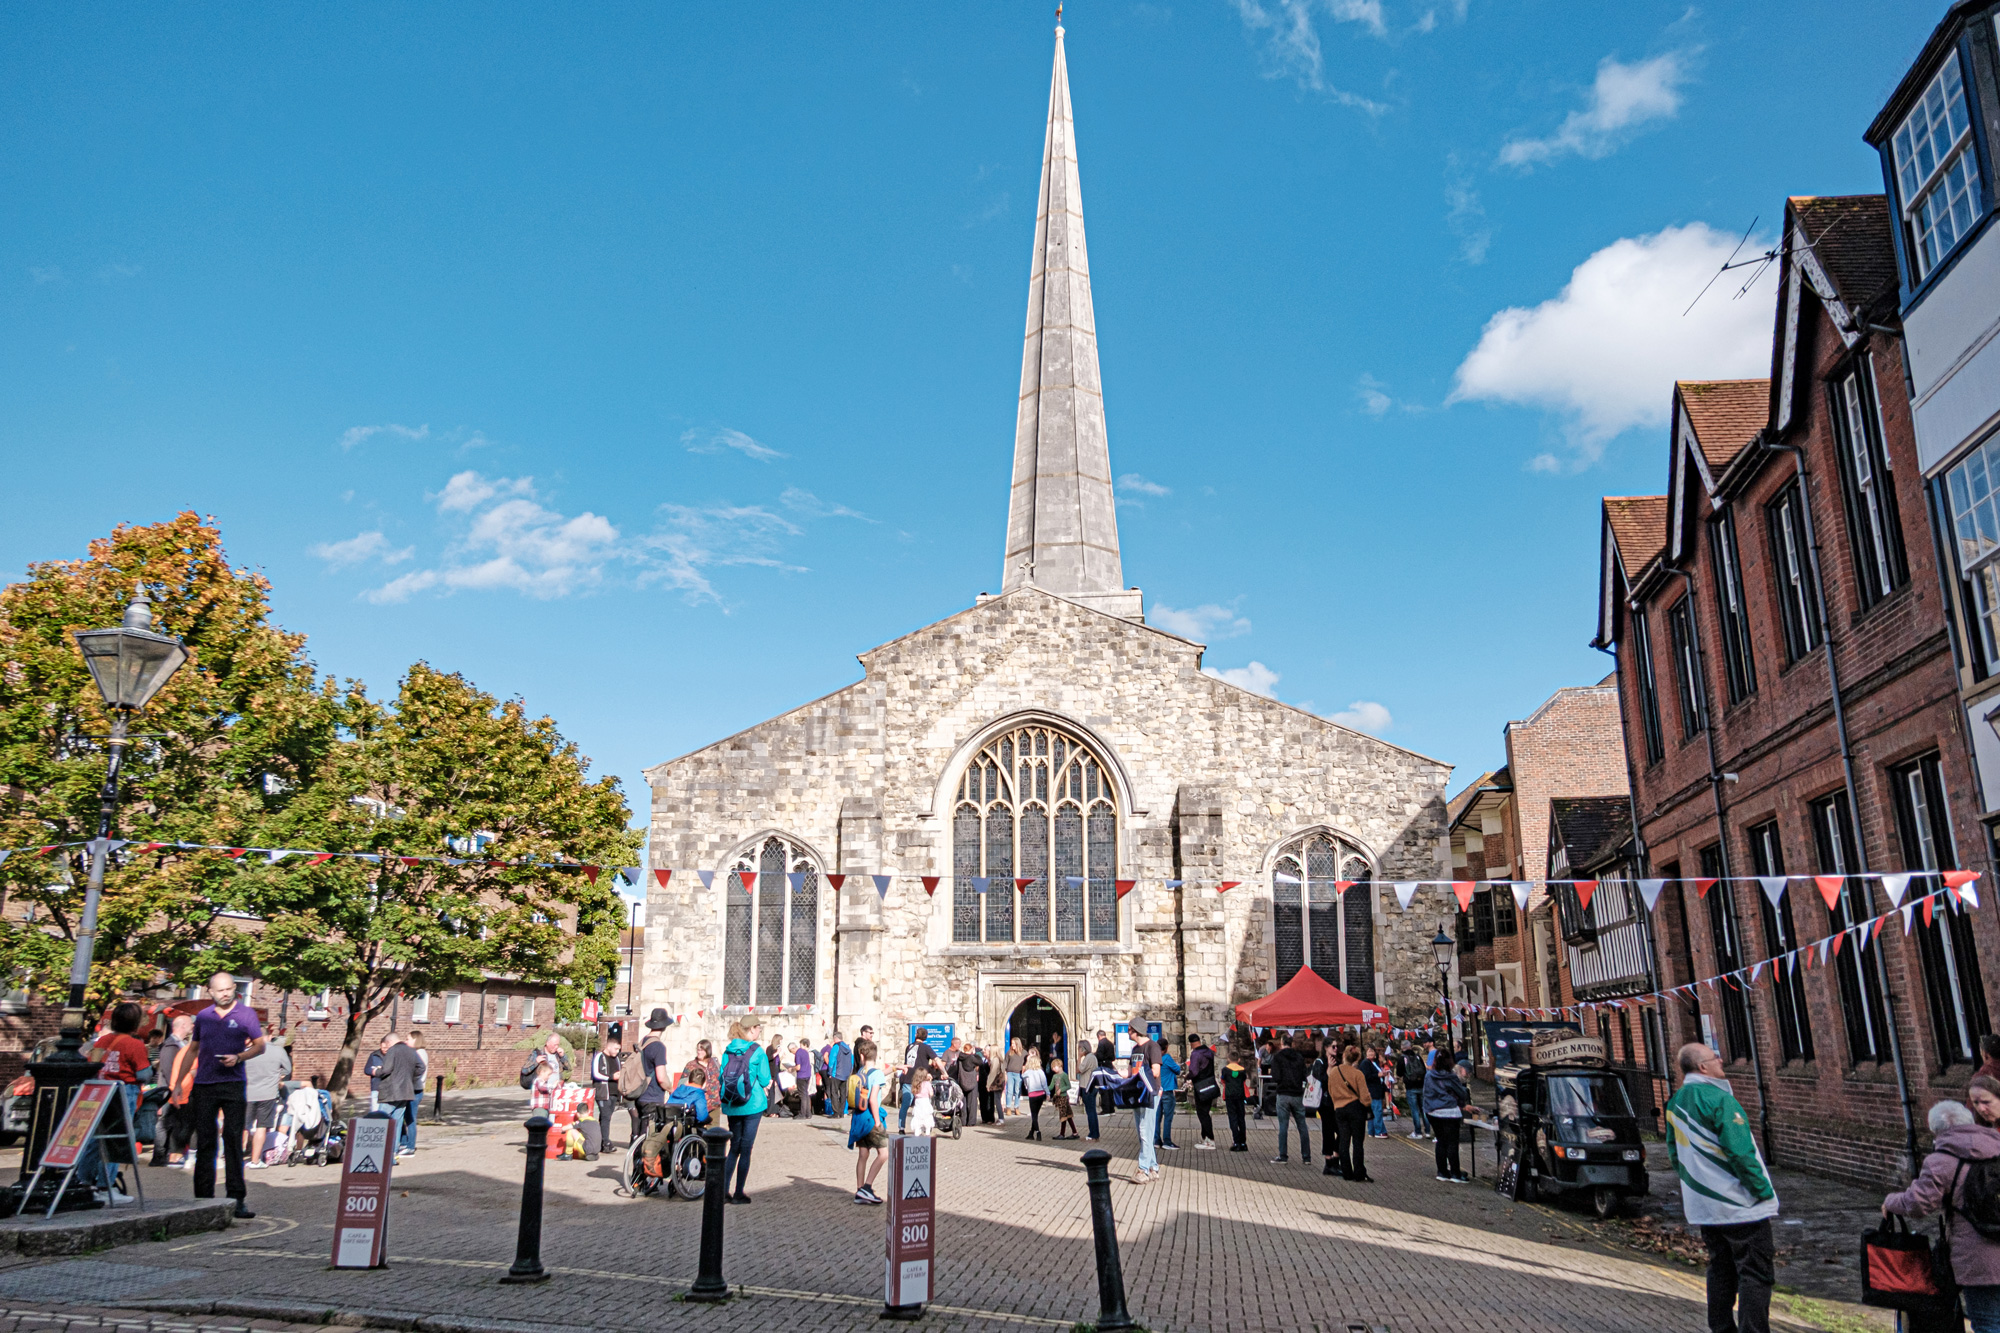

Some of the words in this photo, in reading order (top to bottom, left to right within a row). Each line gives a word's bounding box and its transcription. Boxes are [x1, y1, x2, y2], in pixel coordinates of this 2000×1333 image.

[1536, 1046, 1568, 1060] COFFEE
[1570, 1043, 1603, 1054] NATION
[358, 1126, 385, 1134] TUDOR
[357, 1134, 384, 1142] HOUSE
[905, 1146, 929, 1155] TUDOR
[905, 1155, 929, 1164] HOUSE
[345, 1196, 378, 1212] 800
[902, 1224, 929, 1243] 800
